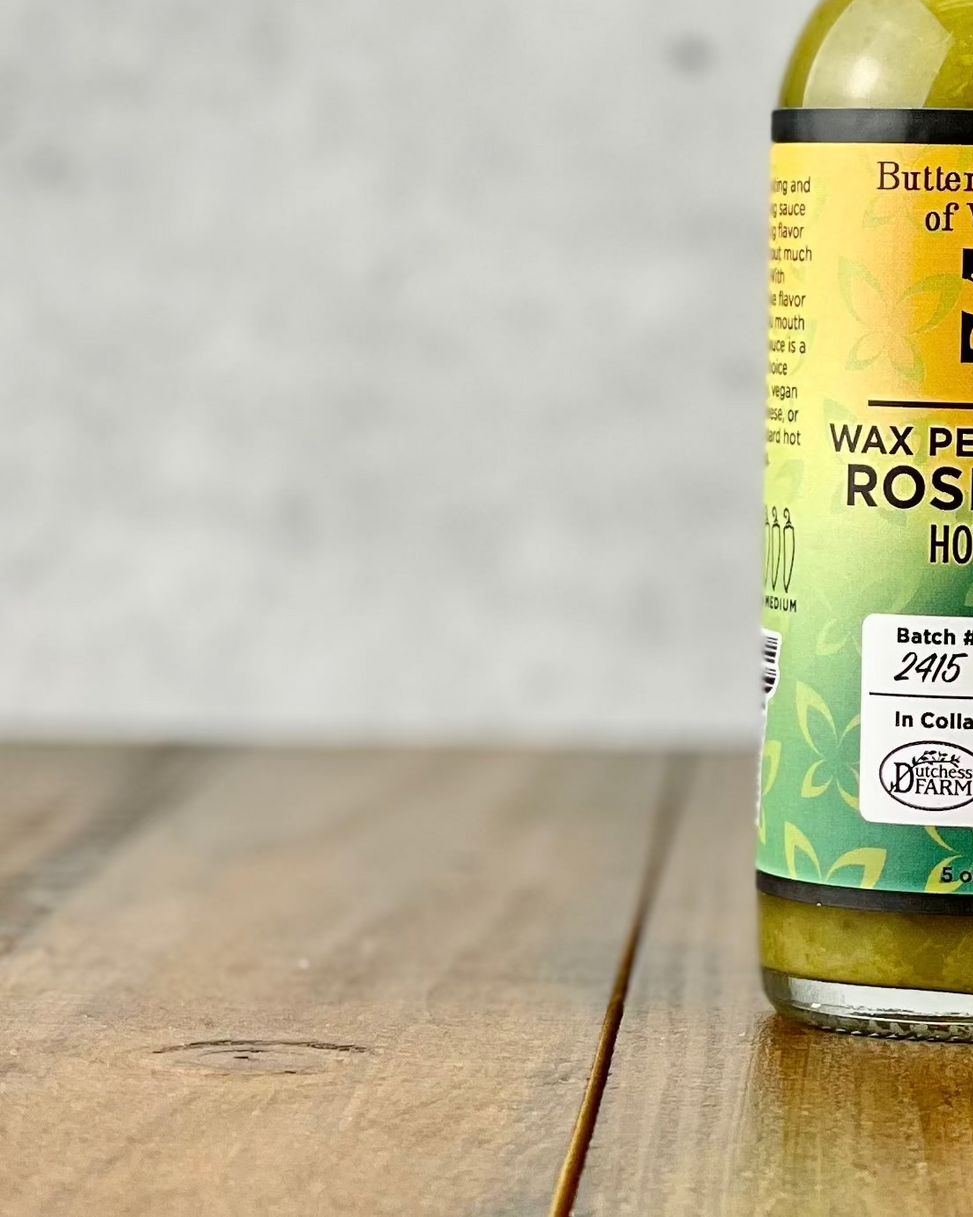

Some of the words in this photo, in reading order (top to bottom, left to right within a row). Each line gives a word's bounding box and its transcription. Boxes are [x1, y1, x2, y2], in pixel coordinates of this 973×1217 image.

[790, 176, 811, 193] and
[779, 202, 806, 216] sauce
[925, 205, 959, 233] of
[778, 222, 804, 239] flavor
[783, 245, 812, 262] much
[778, 290, 806, 307] flavor
[775, 315, 805, 331] mouth
[788, 336, 796, 353] is
[799, 341, 806, 354] a
[771, 385, 798, 401] vegan
[787, 409, 799, 423] or
[783, 428, 801, 446] hot
[830, 423, 914, 456] WAX
[764, 595, 797, 612] MEDIUM
[896, 627, 957, 646] Batch
[894, 651, 968, 683] 2415
[895, 711, 913, 728] In
[893, 762, 973, 793] Dutchess
[915, 778, 973, 796] FARM
[941, 867, 953, 884] 5
